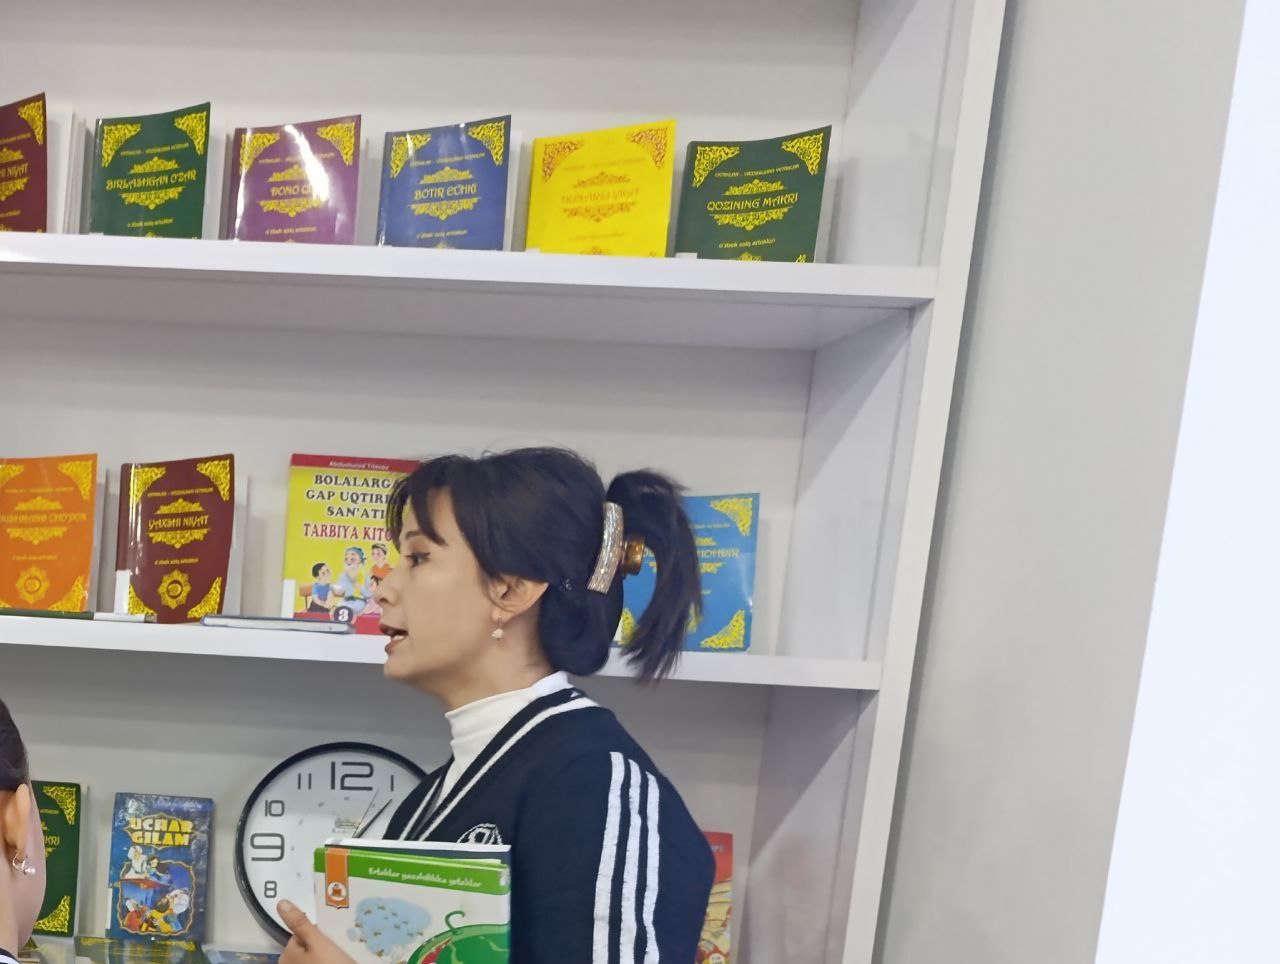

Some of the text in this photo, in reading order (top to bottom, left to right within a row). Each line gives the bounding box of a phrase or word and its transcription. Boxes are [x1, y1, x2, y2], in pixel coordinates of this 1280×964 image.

[106, 175, 169, 190] BIRLASHGAN
[414, 187, 444, 200] BOTIR
[706, 192, 799, 211] QOZINING MAKRI
[306, 489, 336, 501] GAP
[326, 506, 385, 519] SAN'ATI
[148, 515, 209, 530] YAXSHI NIYAT
[303, 523, 393, 541] TARBIYA KITO
[338, 609, 349, 622] 3
[297, 773, 312, 790] 11
[330, 761, 375, 791] 12
[264, 800, 285, 817] 10
[129, 816, 194, 834] UCHAR
[131, 831, 190, 846] GILAM
[250, 833, 285, 862] 9
[264, 880, 278, 899] 8
